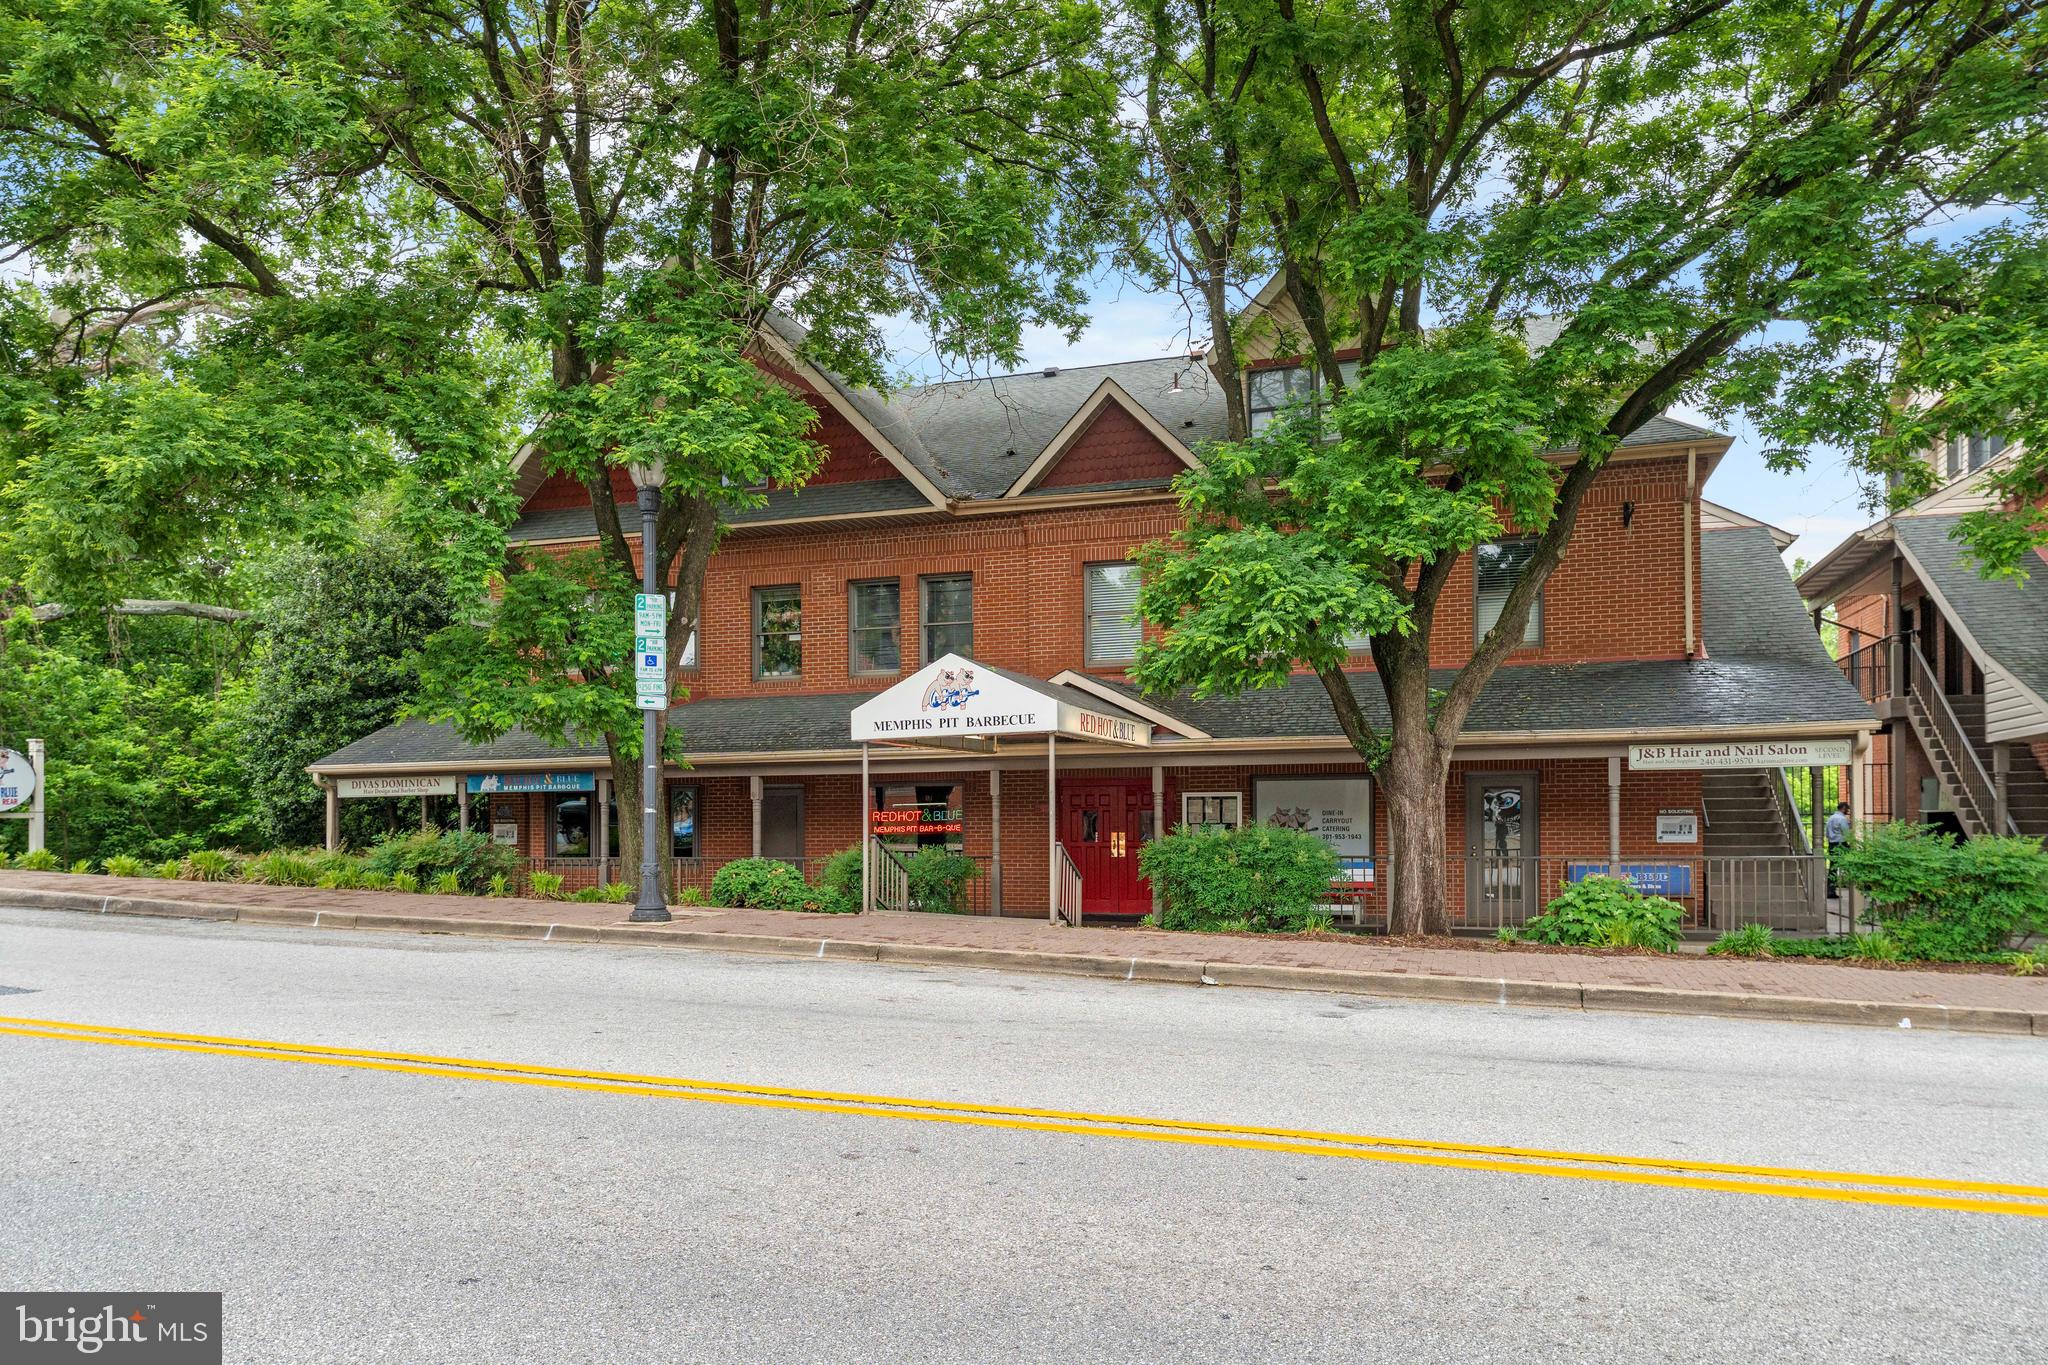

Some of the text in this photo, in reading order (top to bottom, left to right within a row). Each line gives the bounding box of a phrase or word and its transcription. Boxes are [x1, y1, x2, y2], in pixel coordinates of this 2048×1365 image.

[638, 597, 645, 608] 2
[638, 640, 645, 650] 2
[873, 713, 1036, 732] MEMPHIS PIT BARBECUE
[1080, 712, 1097, 733] RED
[1097, 716, 1113, 738] HOT
[1119, 721, 1136, 742] BLUE
[1636, 743, 1808, 762] J&B Hair and Nail Salon
[1700, 757, 1754, 766] 240-431-9570
[351, 778, 440, 789] DIVAS DOMINICAN
[933, 810, 963, 821] BLUE
[873, 825, 906, 833] MEMPHIS
